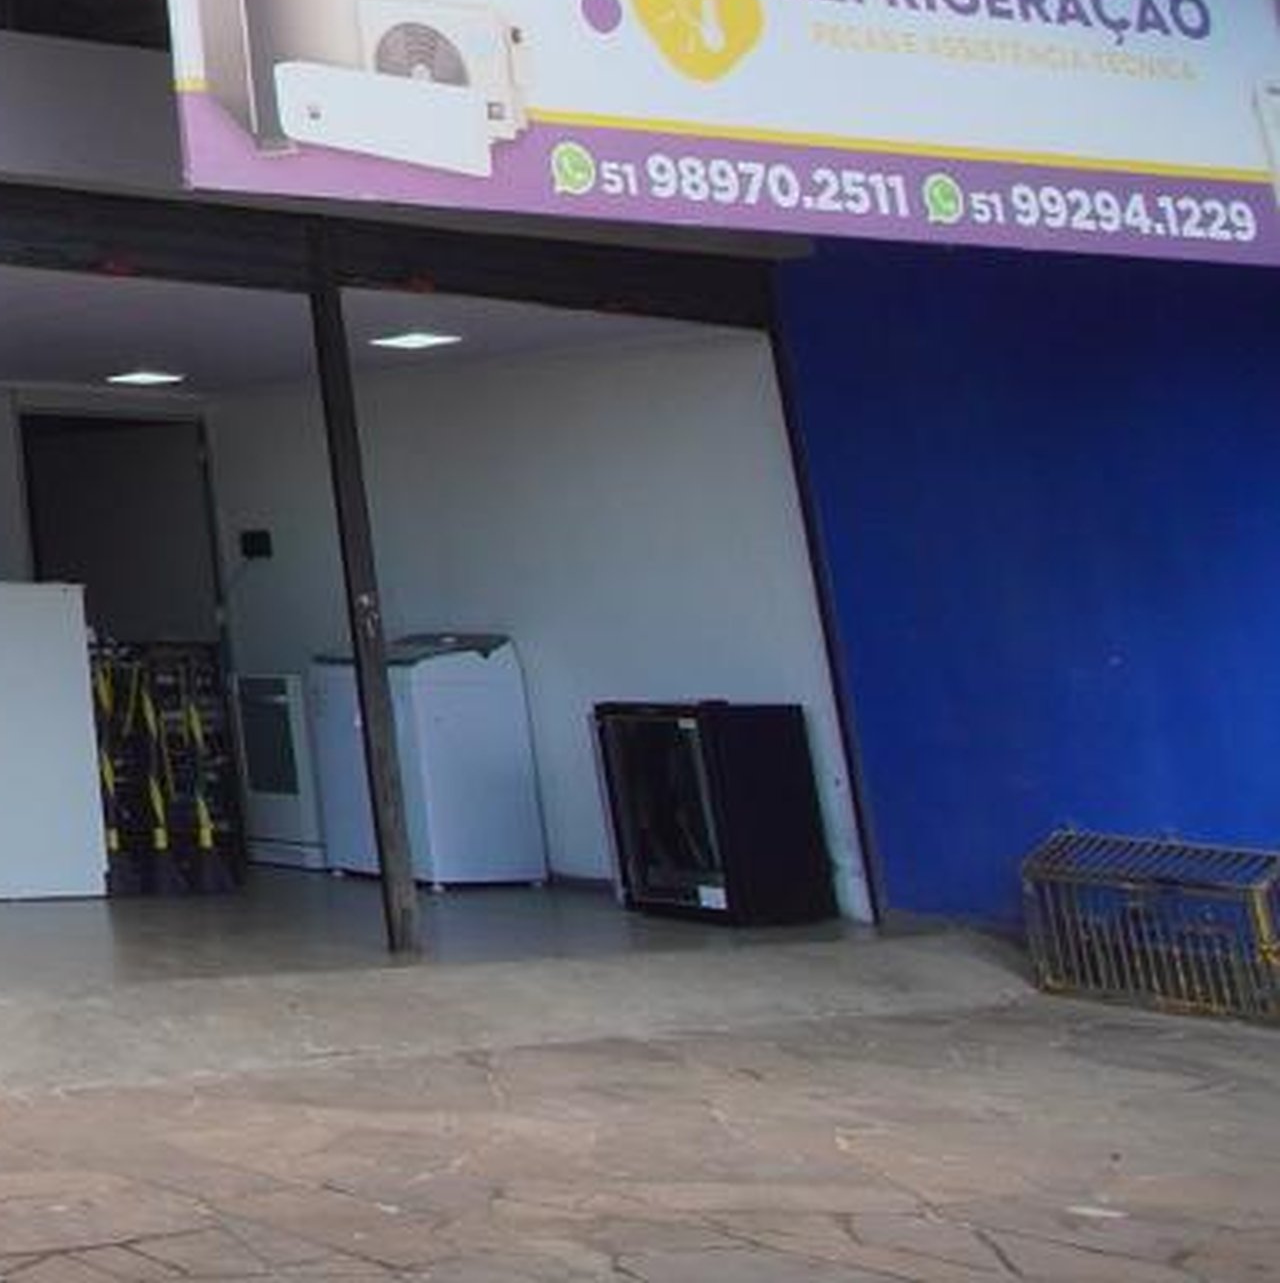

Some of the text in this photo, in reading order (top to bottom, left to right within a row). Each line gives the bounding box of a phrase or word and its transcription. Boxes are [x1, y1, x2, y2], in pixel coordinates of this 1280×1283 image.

[601, 153, 1258, 242] 51 98970.2511 51 99294.1229
